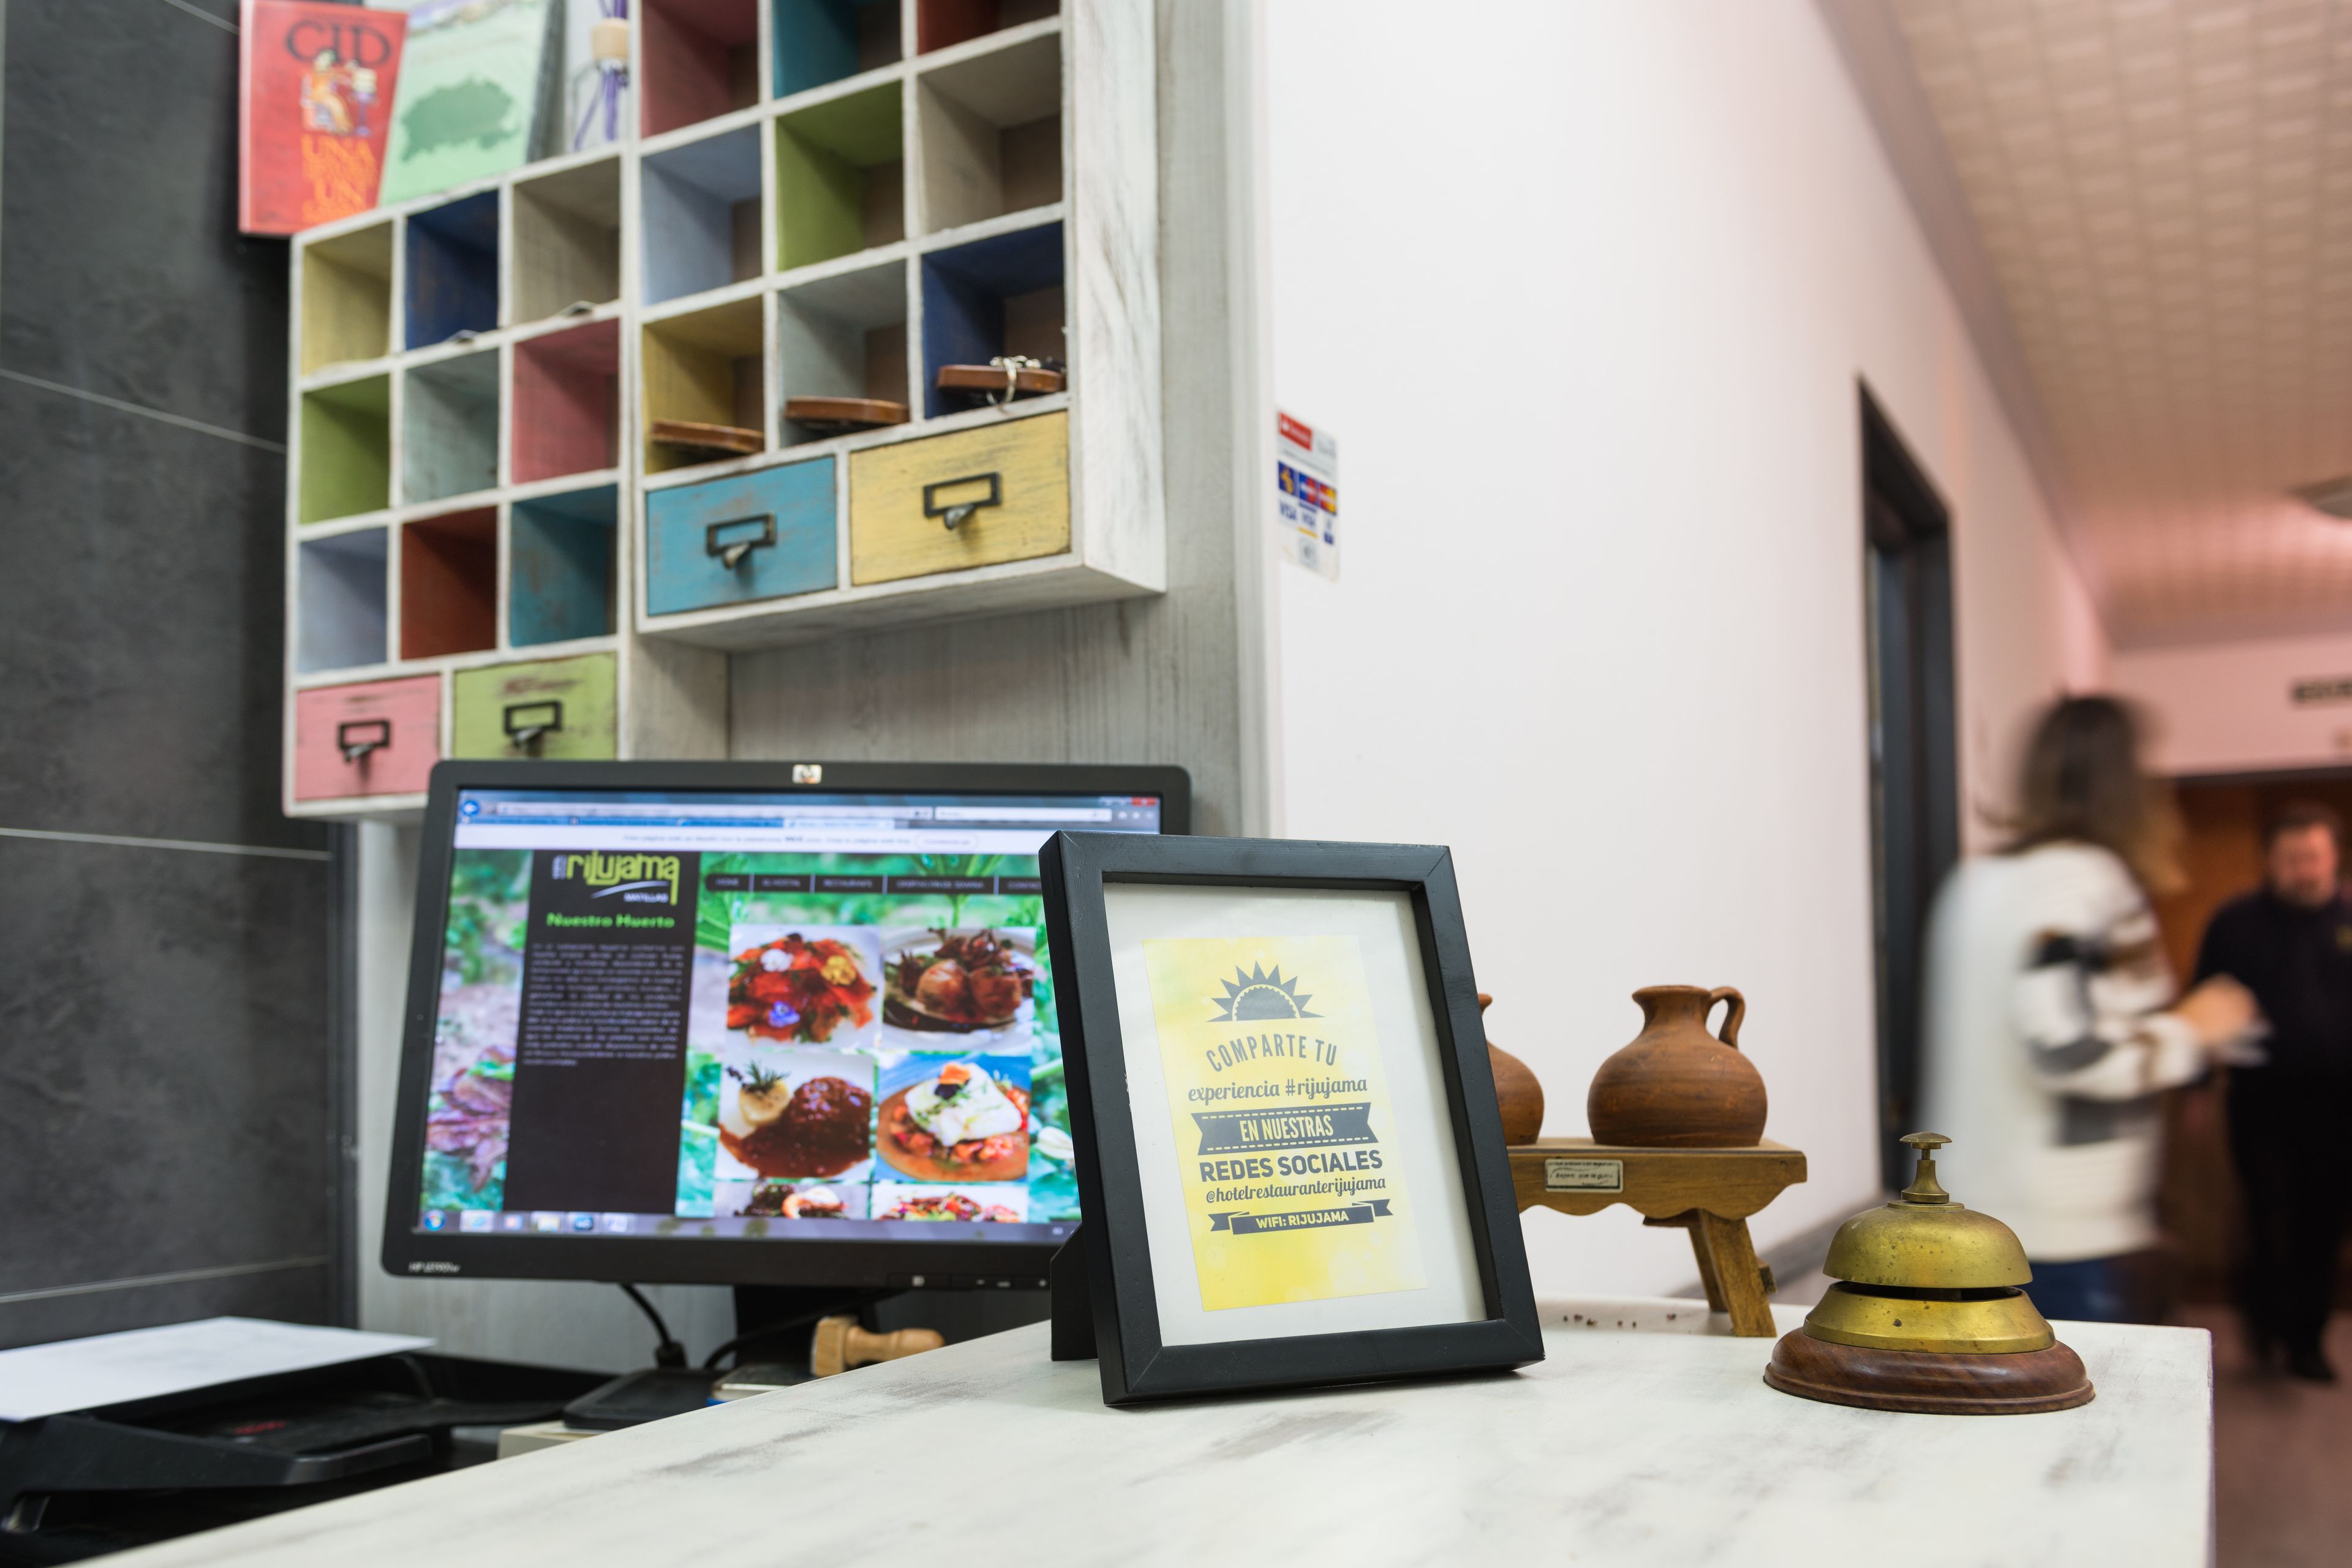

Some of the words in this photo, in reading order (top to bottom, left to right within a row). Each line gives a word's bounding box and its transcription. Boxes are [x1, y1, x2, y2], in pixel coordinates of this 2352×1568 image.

[285, 19, 391, 69] CID
[546, 912, 612, 928] Nuestro
[616, 913, 675, 929] Huerto
[1205, 1033, 1308, 1072] COMPARTE
[1315, 1039, 1337, 1066] TU
[1188, 1080, 1280, 1106] experiencia
[1285, 1077, 1368, 1100] #rijujama
[1239, 1119, 1260, 1142] EN
[1261, 1115, 1334, 1140] NUESTRAS
[1199, 1157, 1274, 1182] REDES
[1277, 1150, 1383, 1176] SOCIALES
[1206, 1177, 1386, 1204] @hotelrestauranterijujama
[1255, 1216, 1287, 1229] WIFI:
[1288, 1210, 1349, 1226] RIJUJAMA
